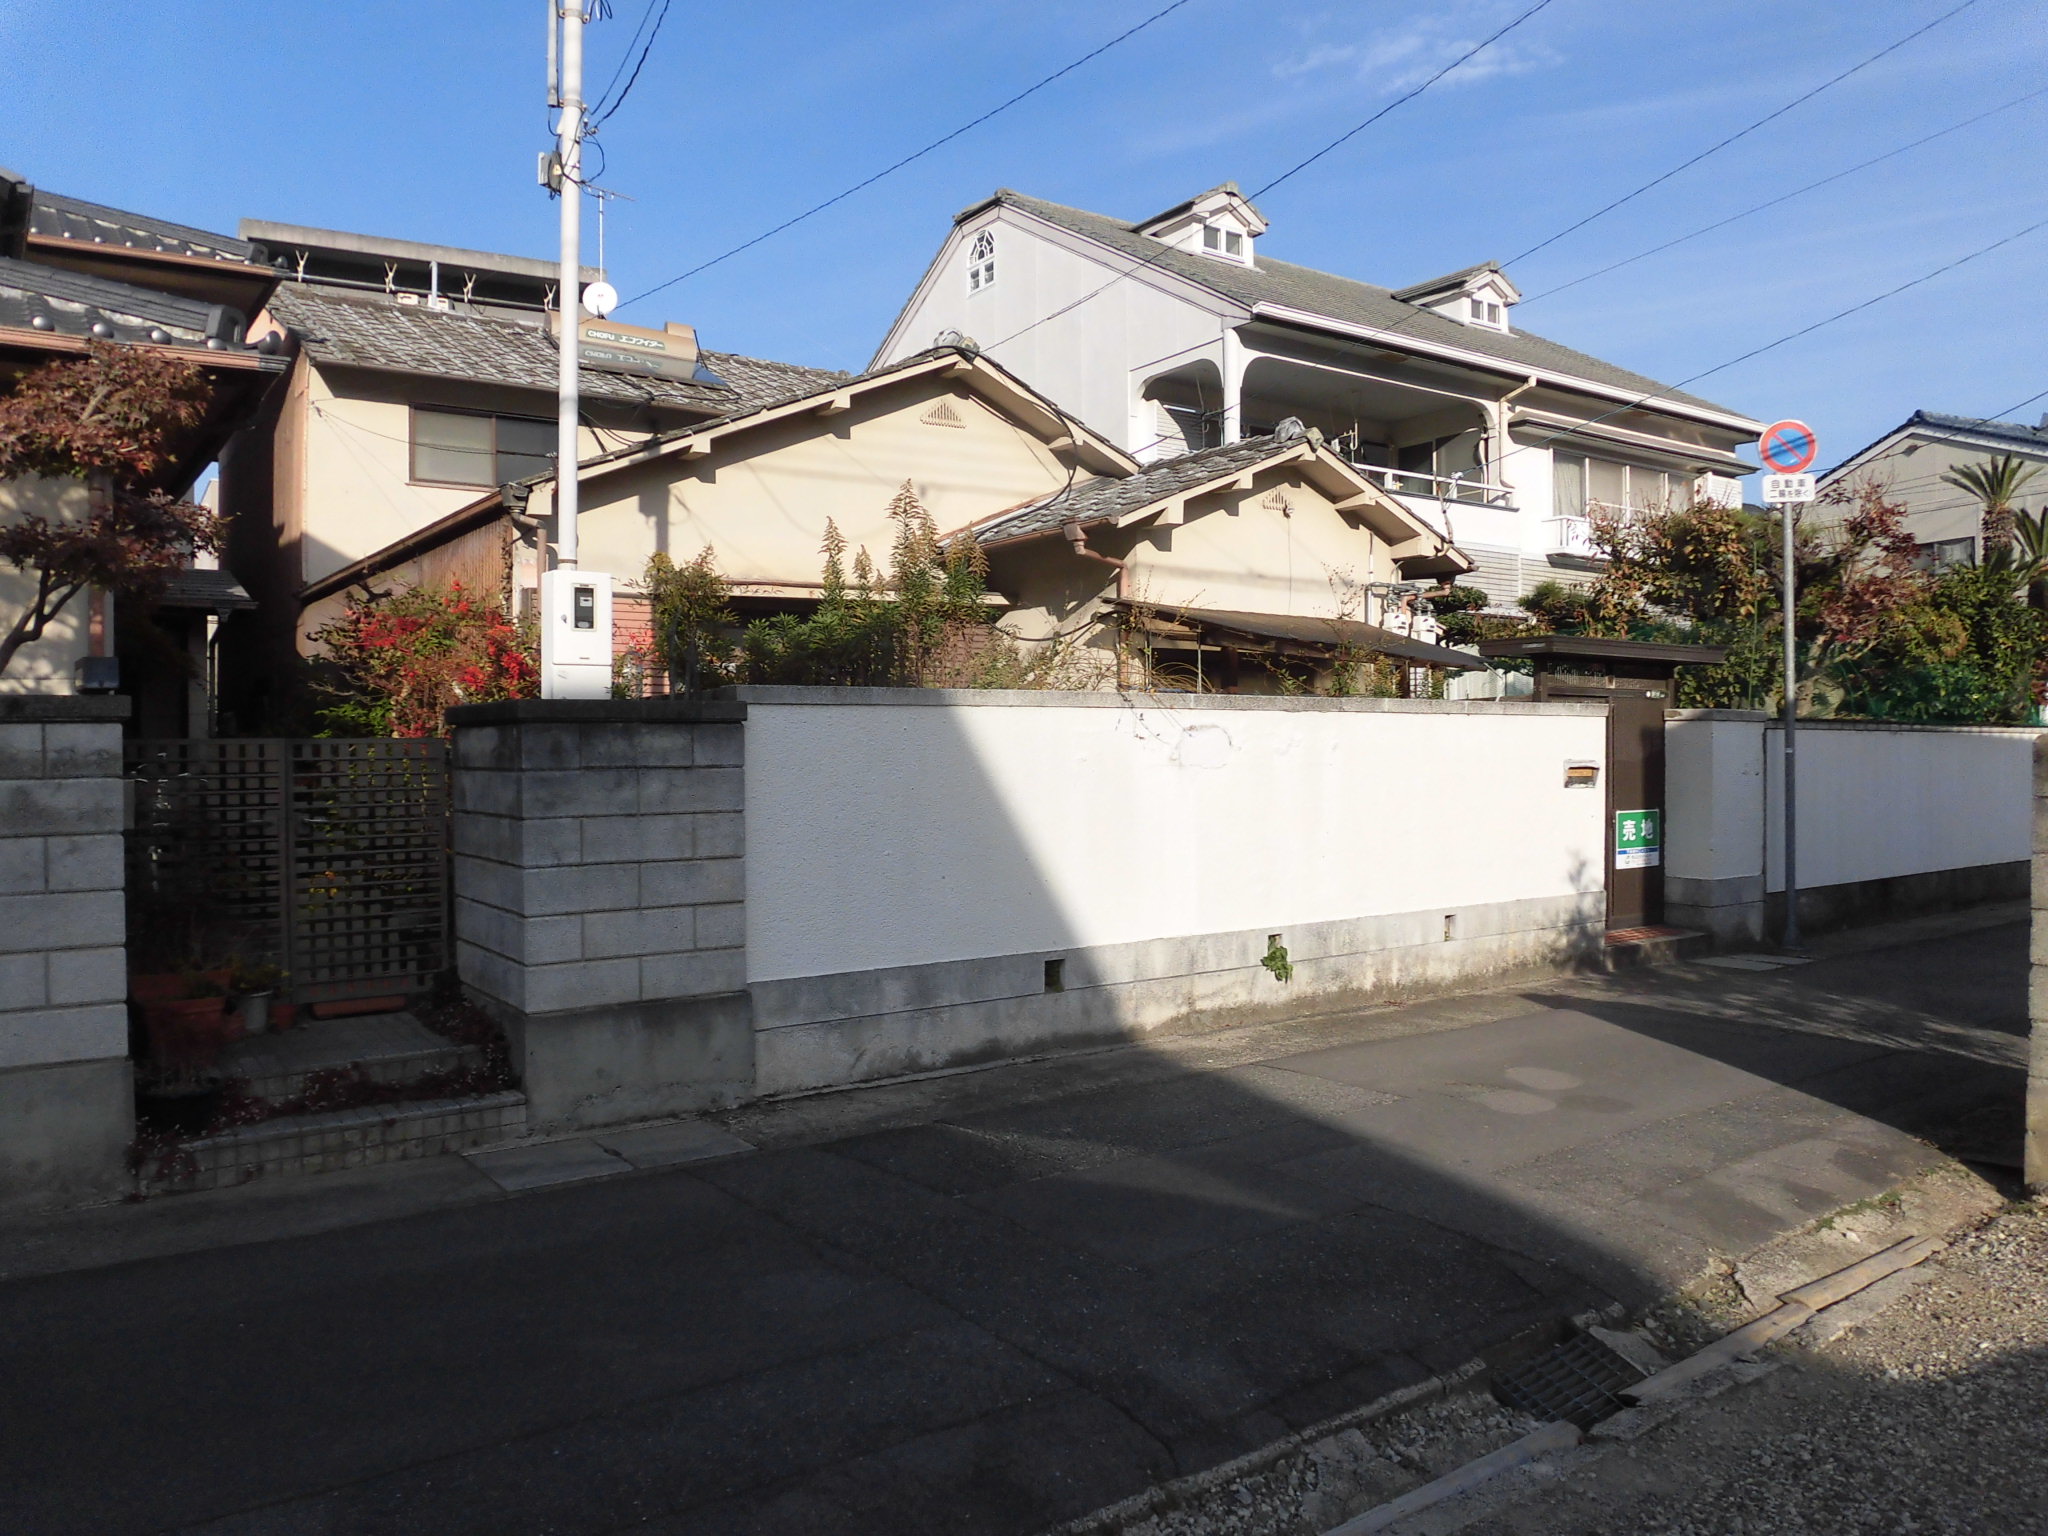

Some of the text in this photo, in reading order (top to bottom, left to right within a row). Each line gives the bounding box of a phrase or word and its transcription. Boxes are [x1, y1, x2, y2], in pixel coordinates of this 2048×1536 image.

[587, 330, 615, 340] CHOFU
[1771, 479, 1806, 488] 自動車
[1622, 818, 1654, 841] 売地
